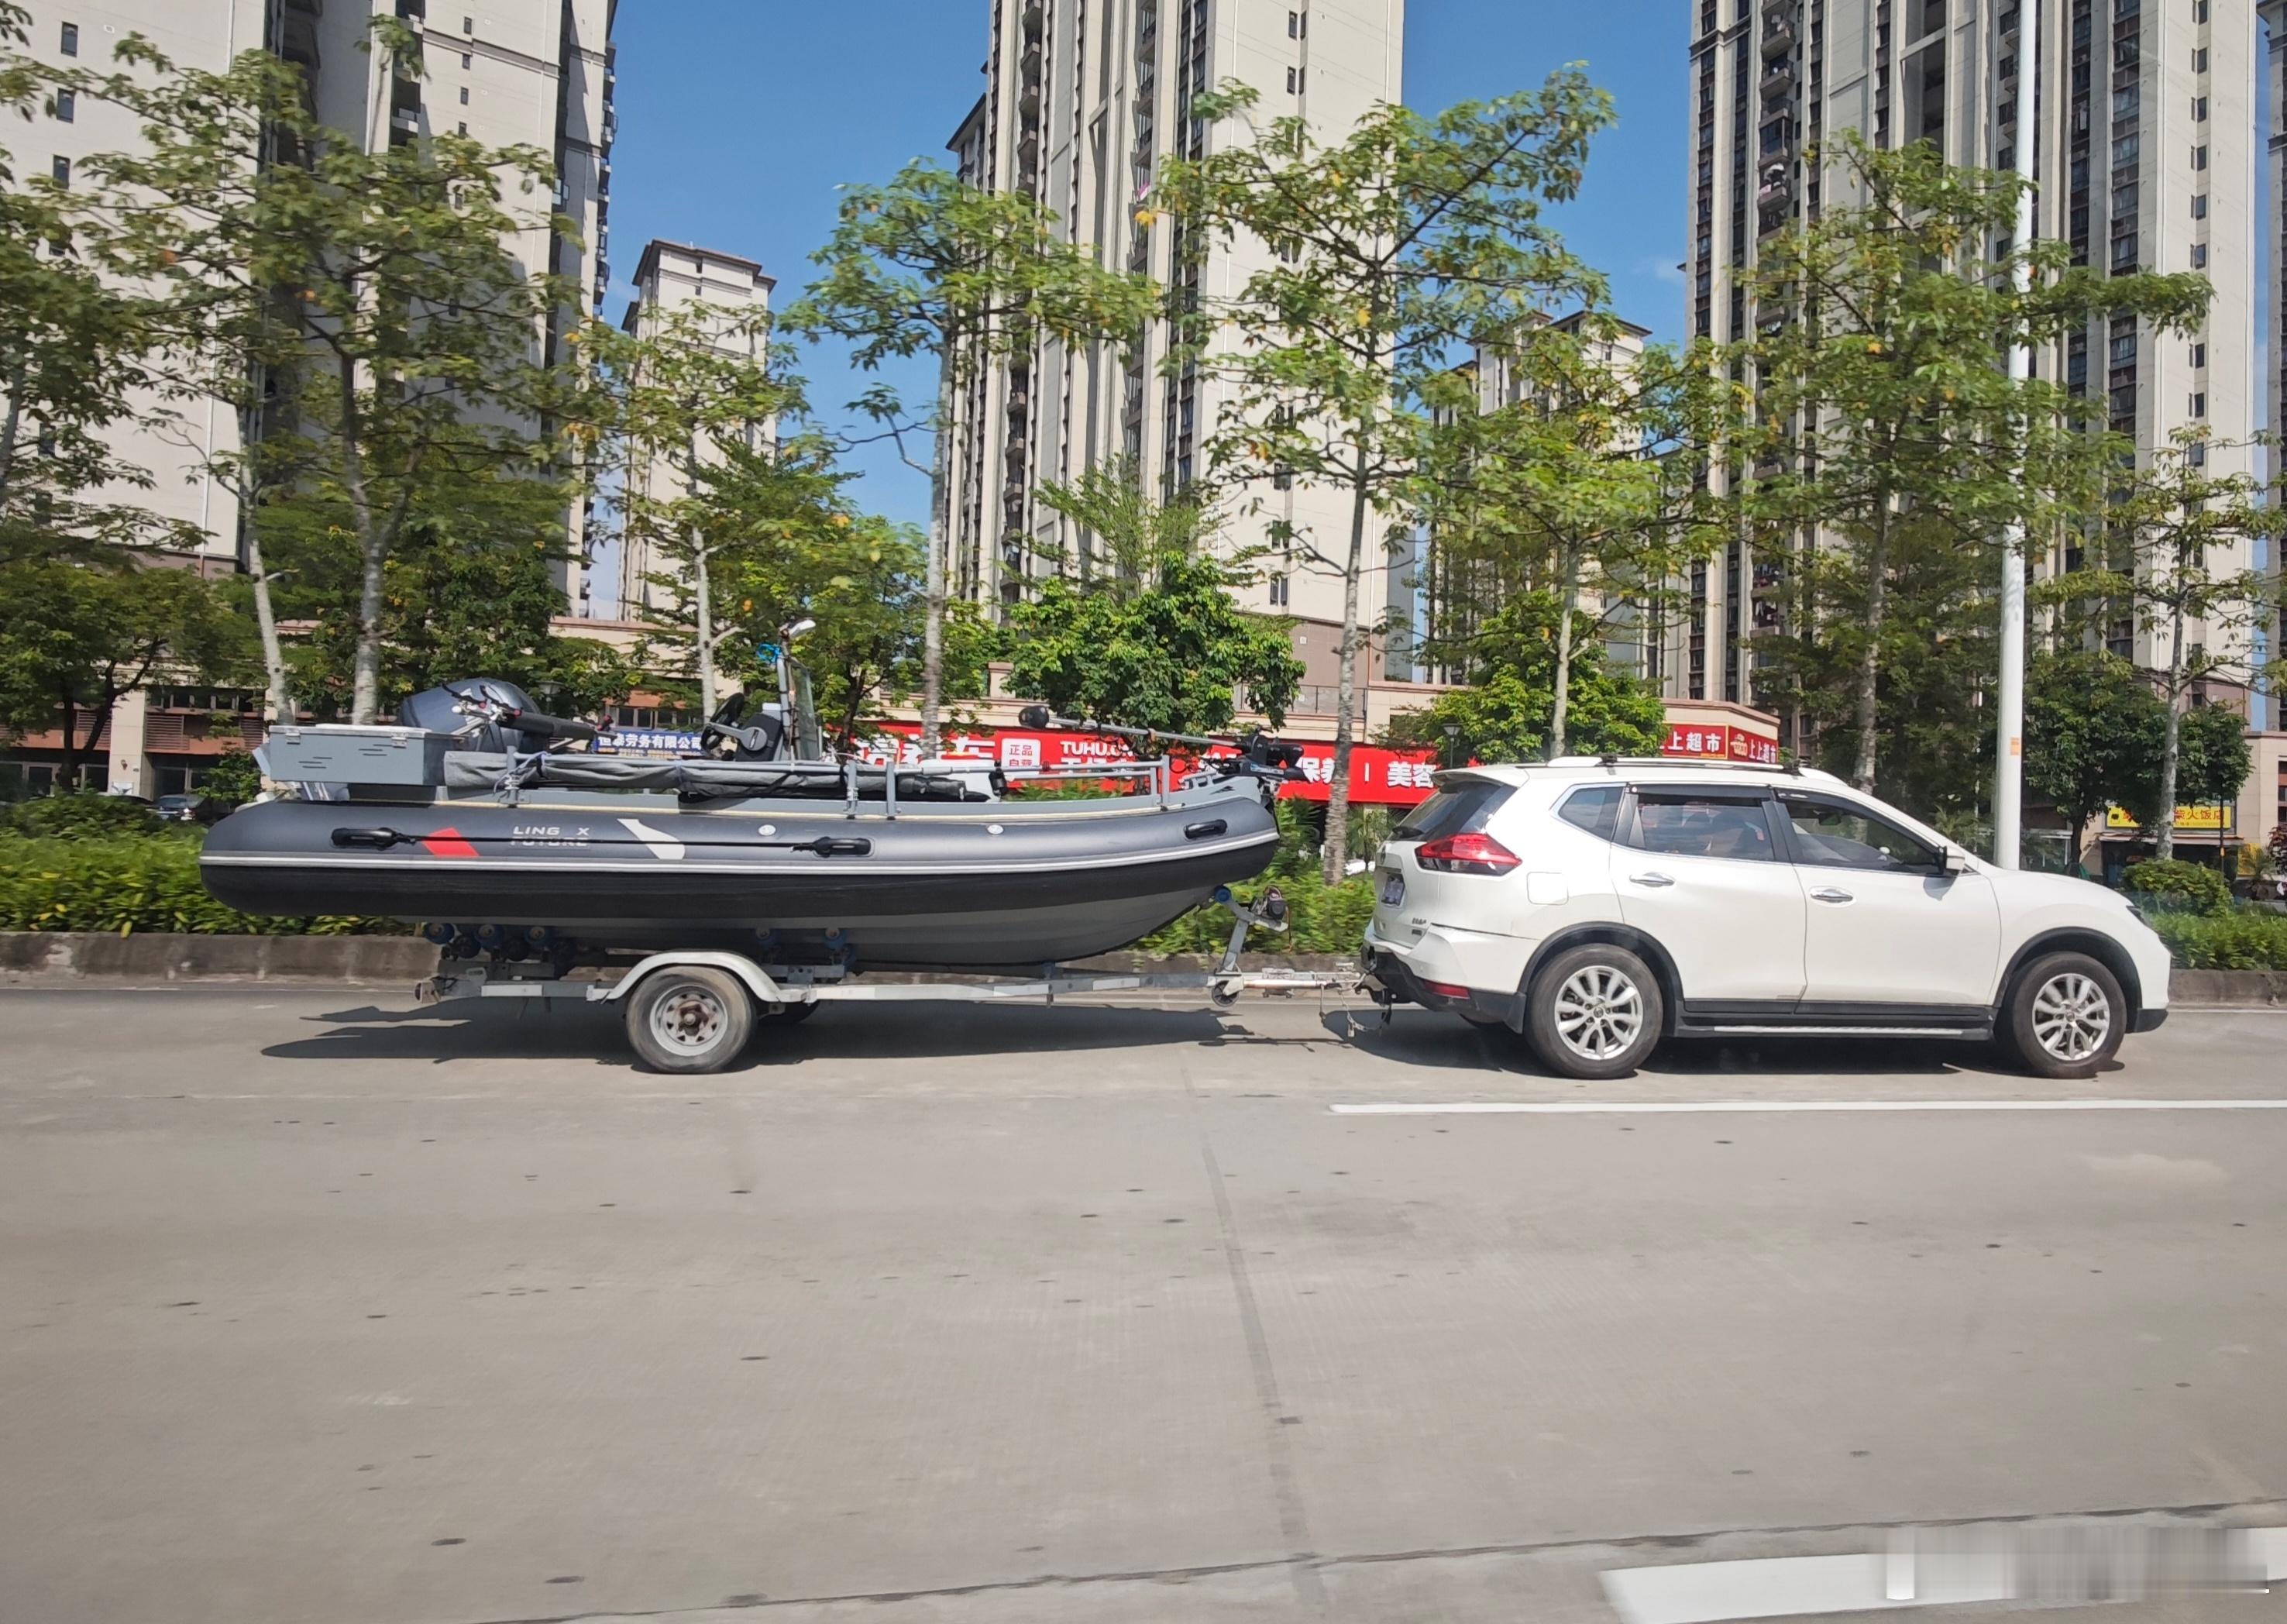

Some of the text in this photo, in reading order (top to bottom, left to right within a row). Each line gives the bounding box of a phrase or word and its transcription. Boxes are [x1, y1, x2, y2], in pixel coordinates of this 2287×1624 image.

[1009, 745, 1033, 756] 正品
[1749, 738, 1776, 763] 上上超市
[1388, 761, 1436, 788] 美容
[513, 826, 590, 836] LING X
